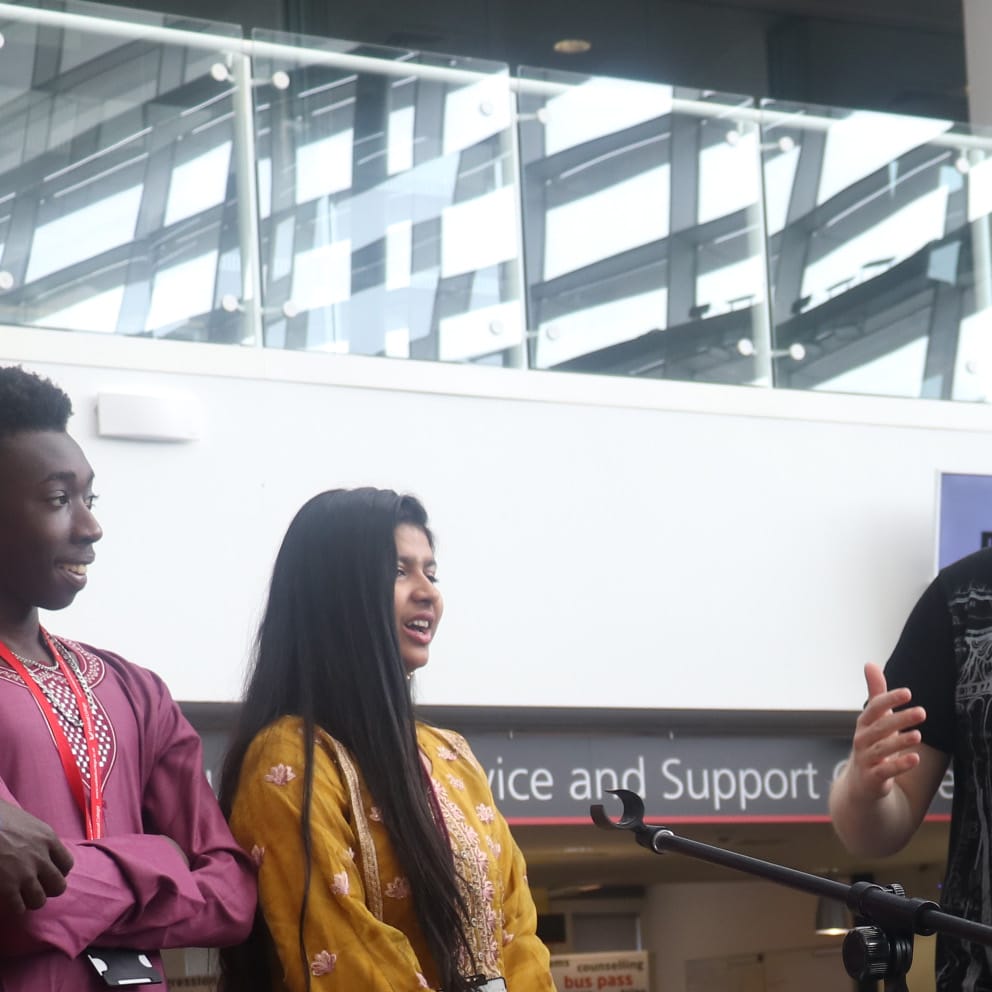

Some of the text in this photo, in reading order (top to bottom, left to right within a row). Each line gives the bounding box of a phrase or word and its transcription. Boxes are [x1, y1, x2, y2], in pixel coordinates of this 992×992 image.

[569, 756, 646, 801] and
[661, 758, 820, 811] Support
[564, 975, 633, 991] bus pass
